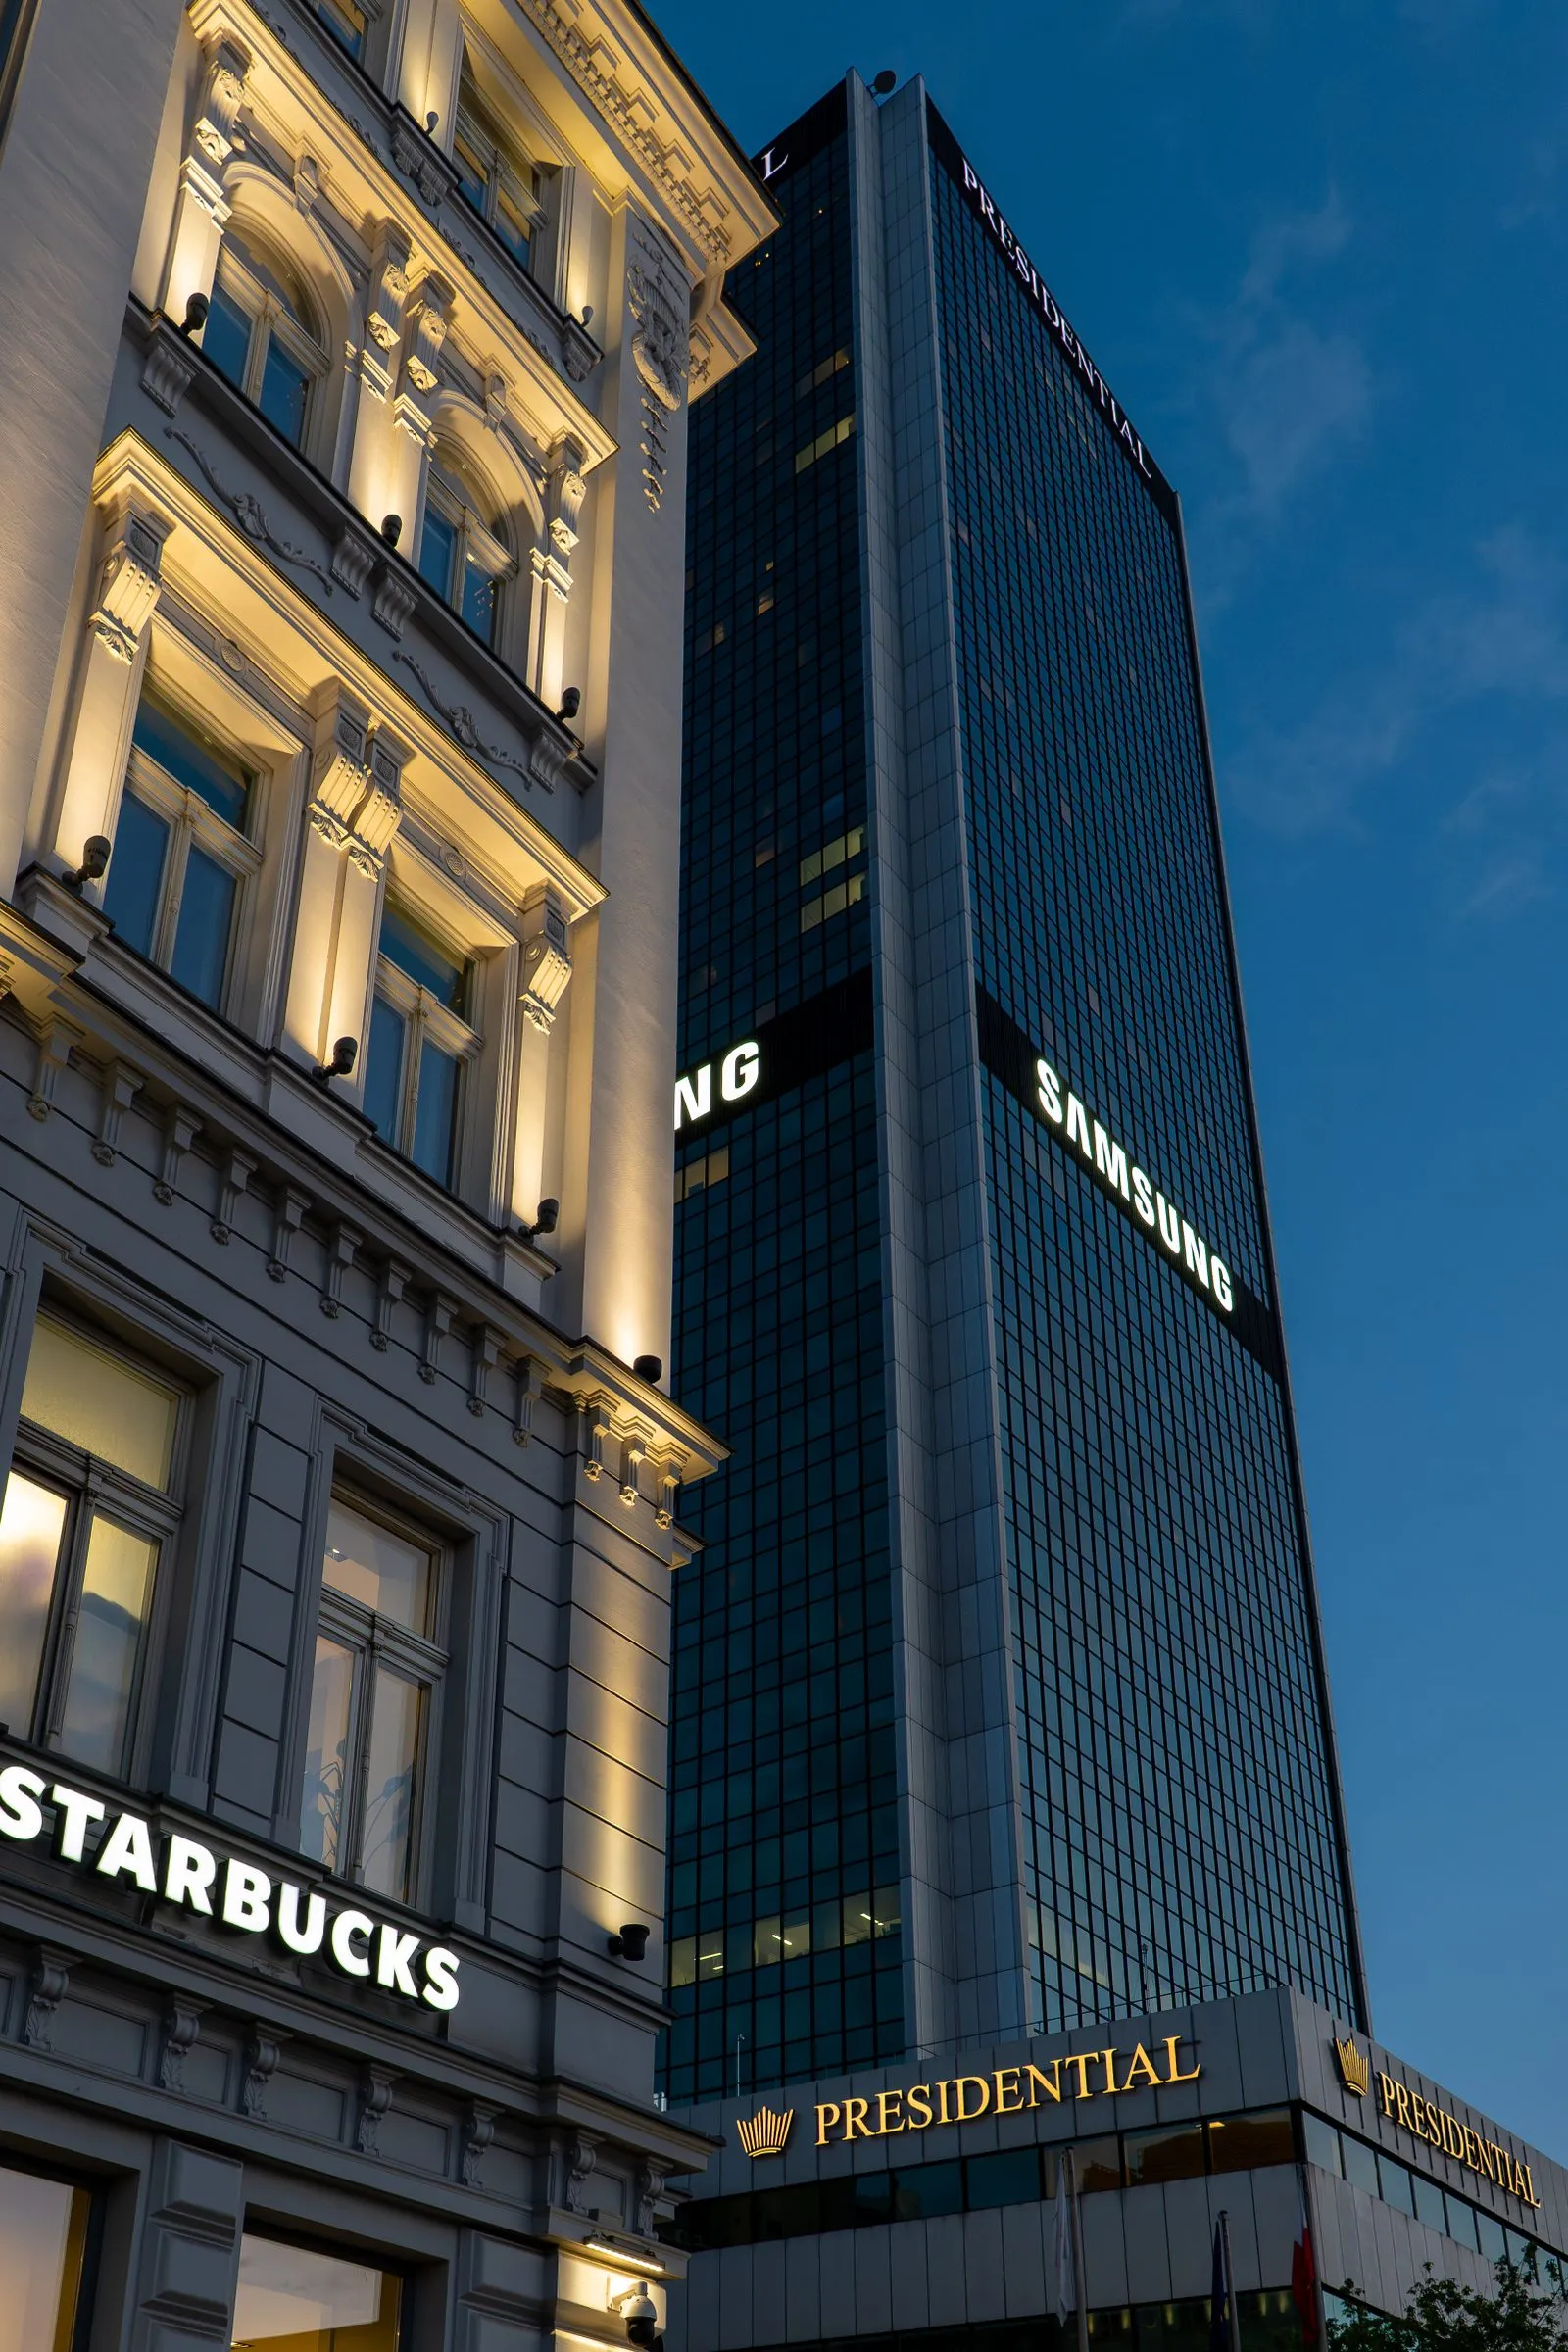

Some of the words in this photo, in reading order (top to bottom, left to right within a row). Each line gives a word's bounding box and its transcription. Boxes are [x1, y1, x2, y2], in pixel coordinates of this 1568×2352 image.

[962, 158, 1152, 478] PRESIDENTIAL
[1037, 1059, 1233, 1311] SAMSUNG
[0, 1766, 460, 2011] STARBUCKS
[814, 2035, 1200, 2146] PRESIDENTIAL
[1379, 2071, 1541, 2208] PRESIDENTIAL
